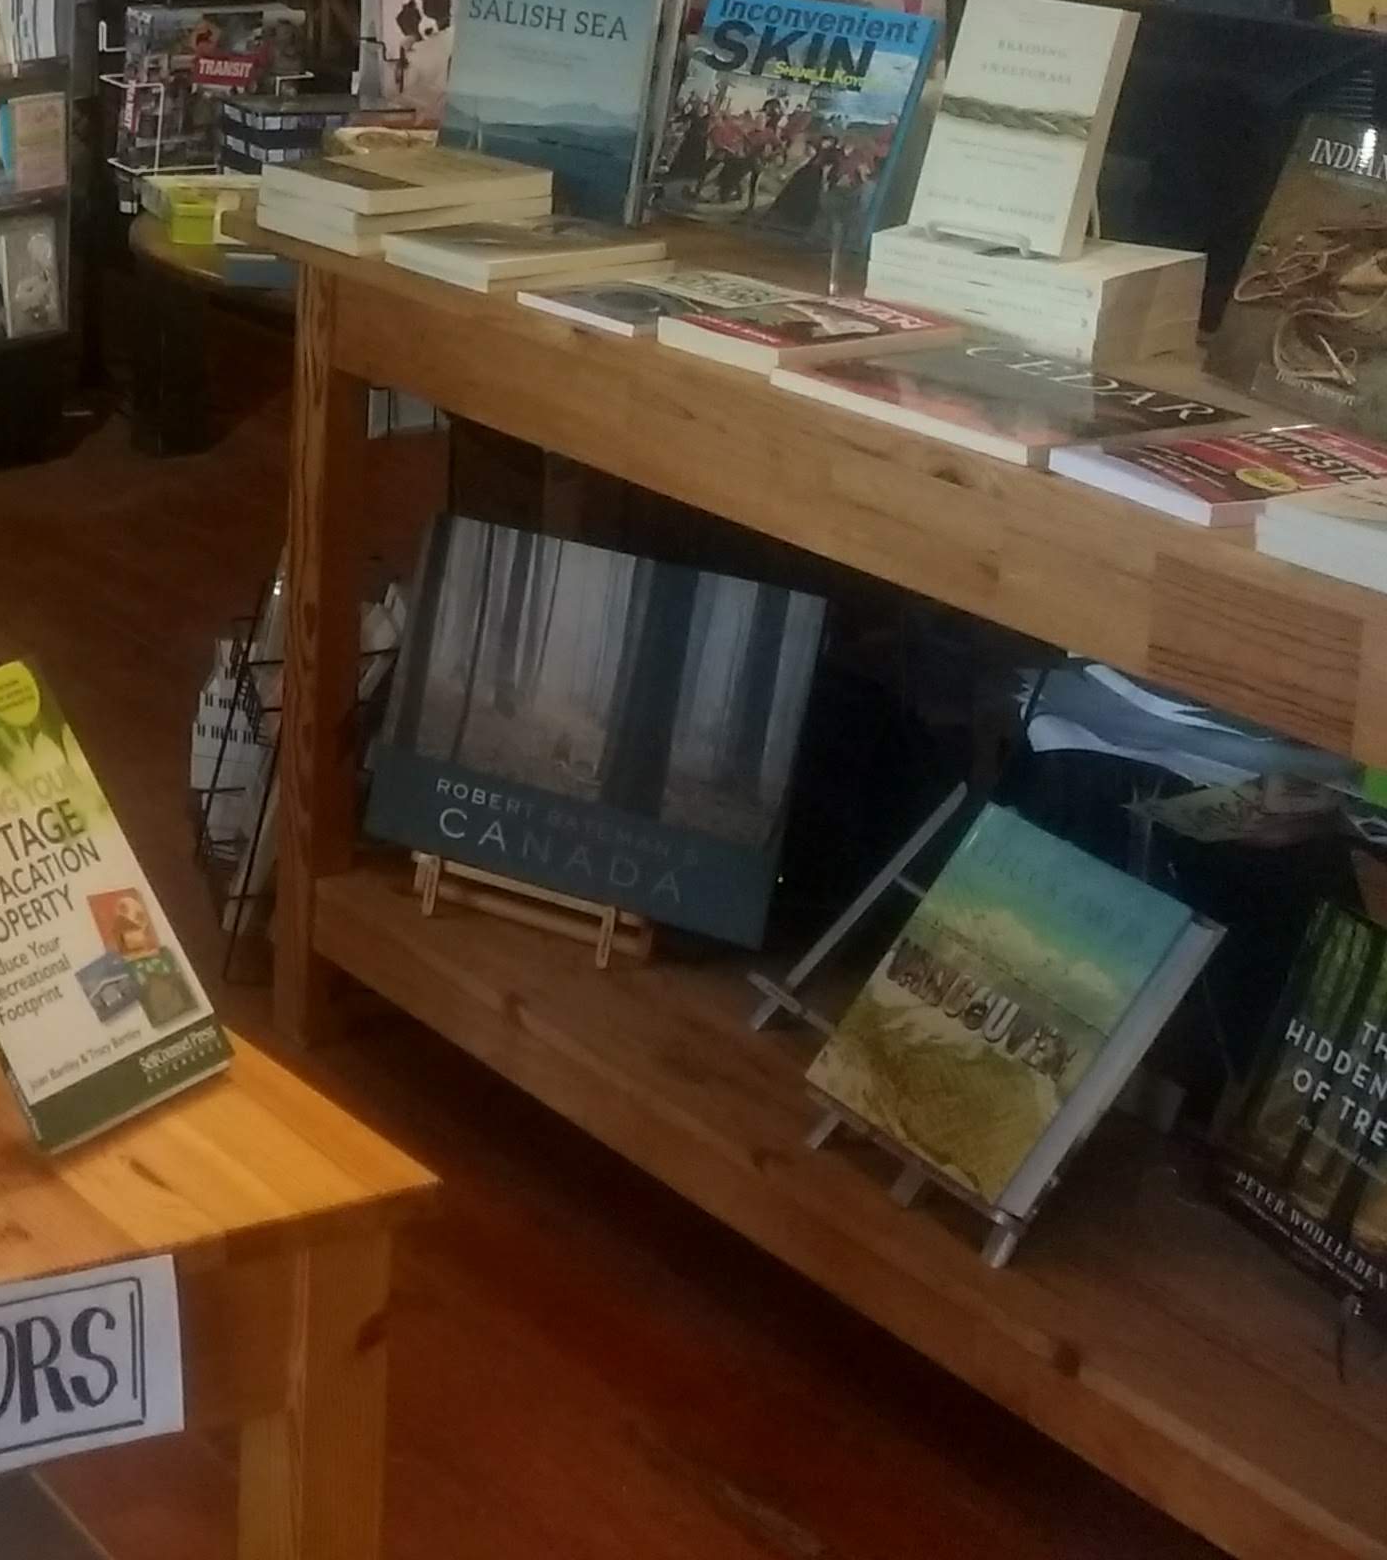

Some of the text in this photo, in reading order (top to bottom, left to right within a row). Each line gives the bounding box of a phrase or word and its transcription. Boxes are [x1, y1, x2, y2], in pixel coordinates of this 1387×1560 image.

[573, 10, 628, 42] SEA
[197, 58, 254, 80] TRANSIT
[704, 18, 876, 81] SKIN
[962, 342, 1225, 425] CEDAR
[435, 777, 535, 819] ROBERT
[438, 807, 681, 905] CANADA
[30, 935, 62, 963] Your
[1284, 1018, 1387, 1100] HIDDEN
[1293, 1068, 1331, 1104] OF
[1235, 1170, 1287, 1214] PETER
